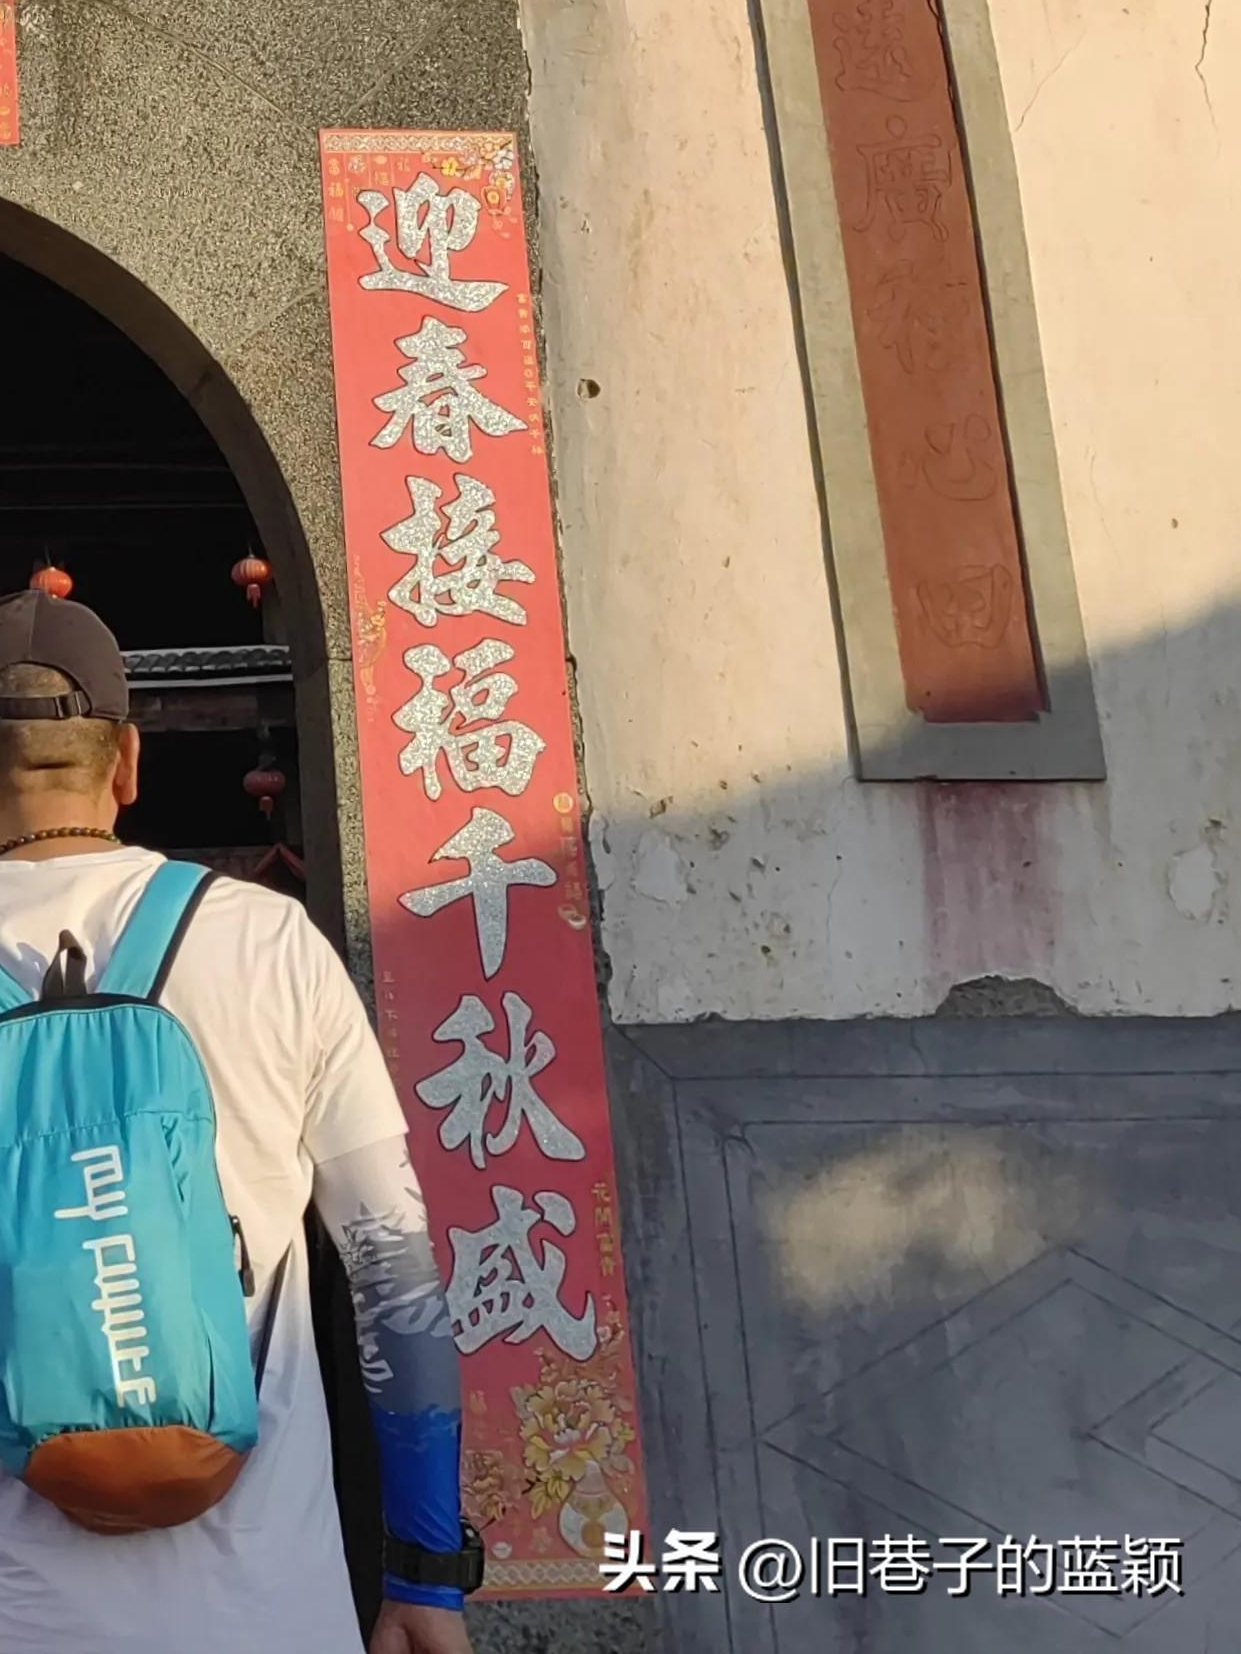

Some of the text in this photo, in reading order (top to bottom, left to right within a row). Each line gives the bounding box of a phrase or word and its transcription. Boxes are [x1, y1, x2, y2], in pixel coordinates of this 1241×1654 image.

[357, 171, 598, 1360] 迎春接福千秋盛
